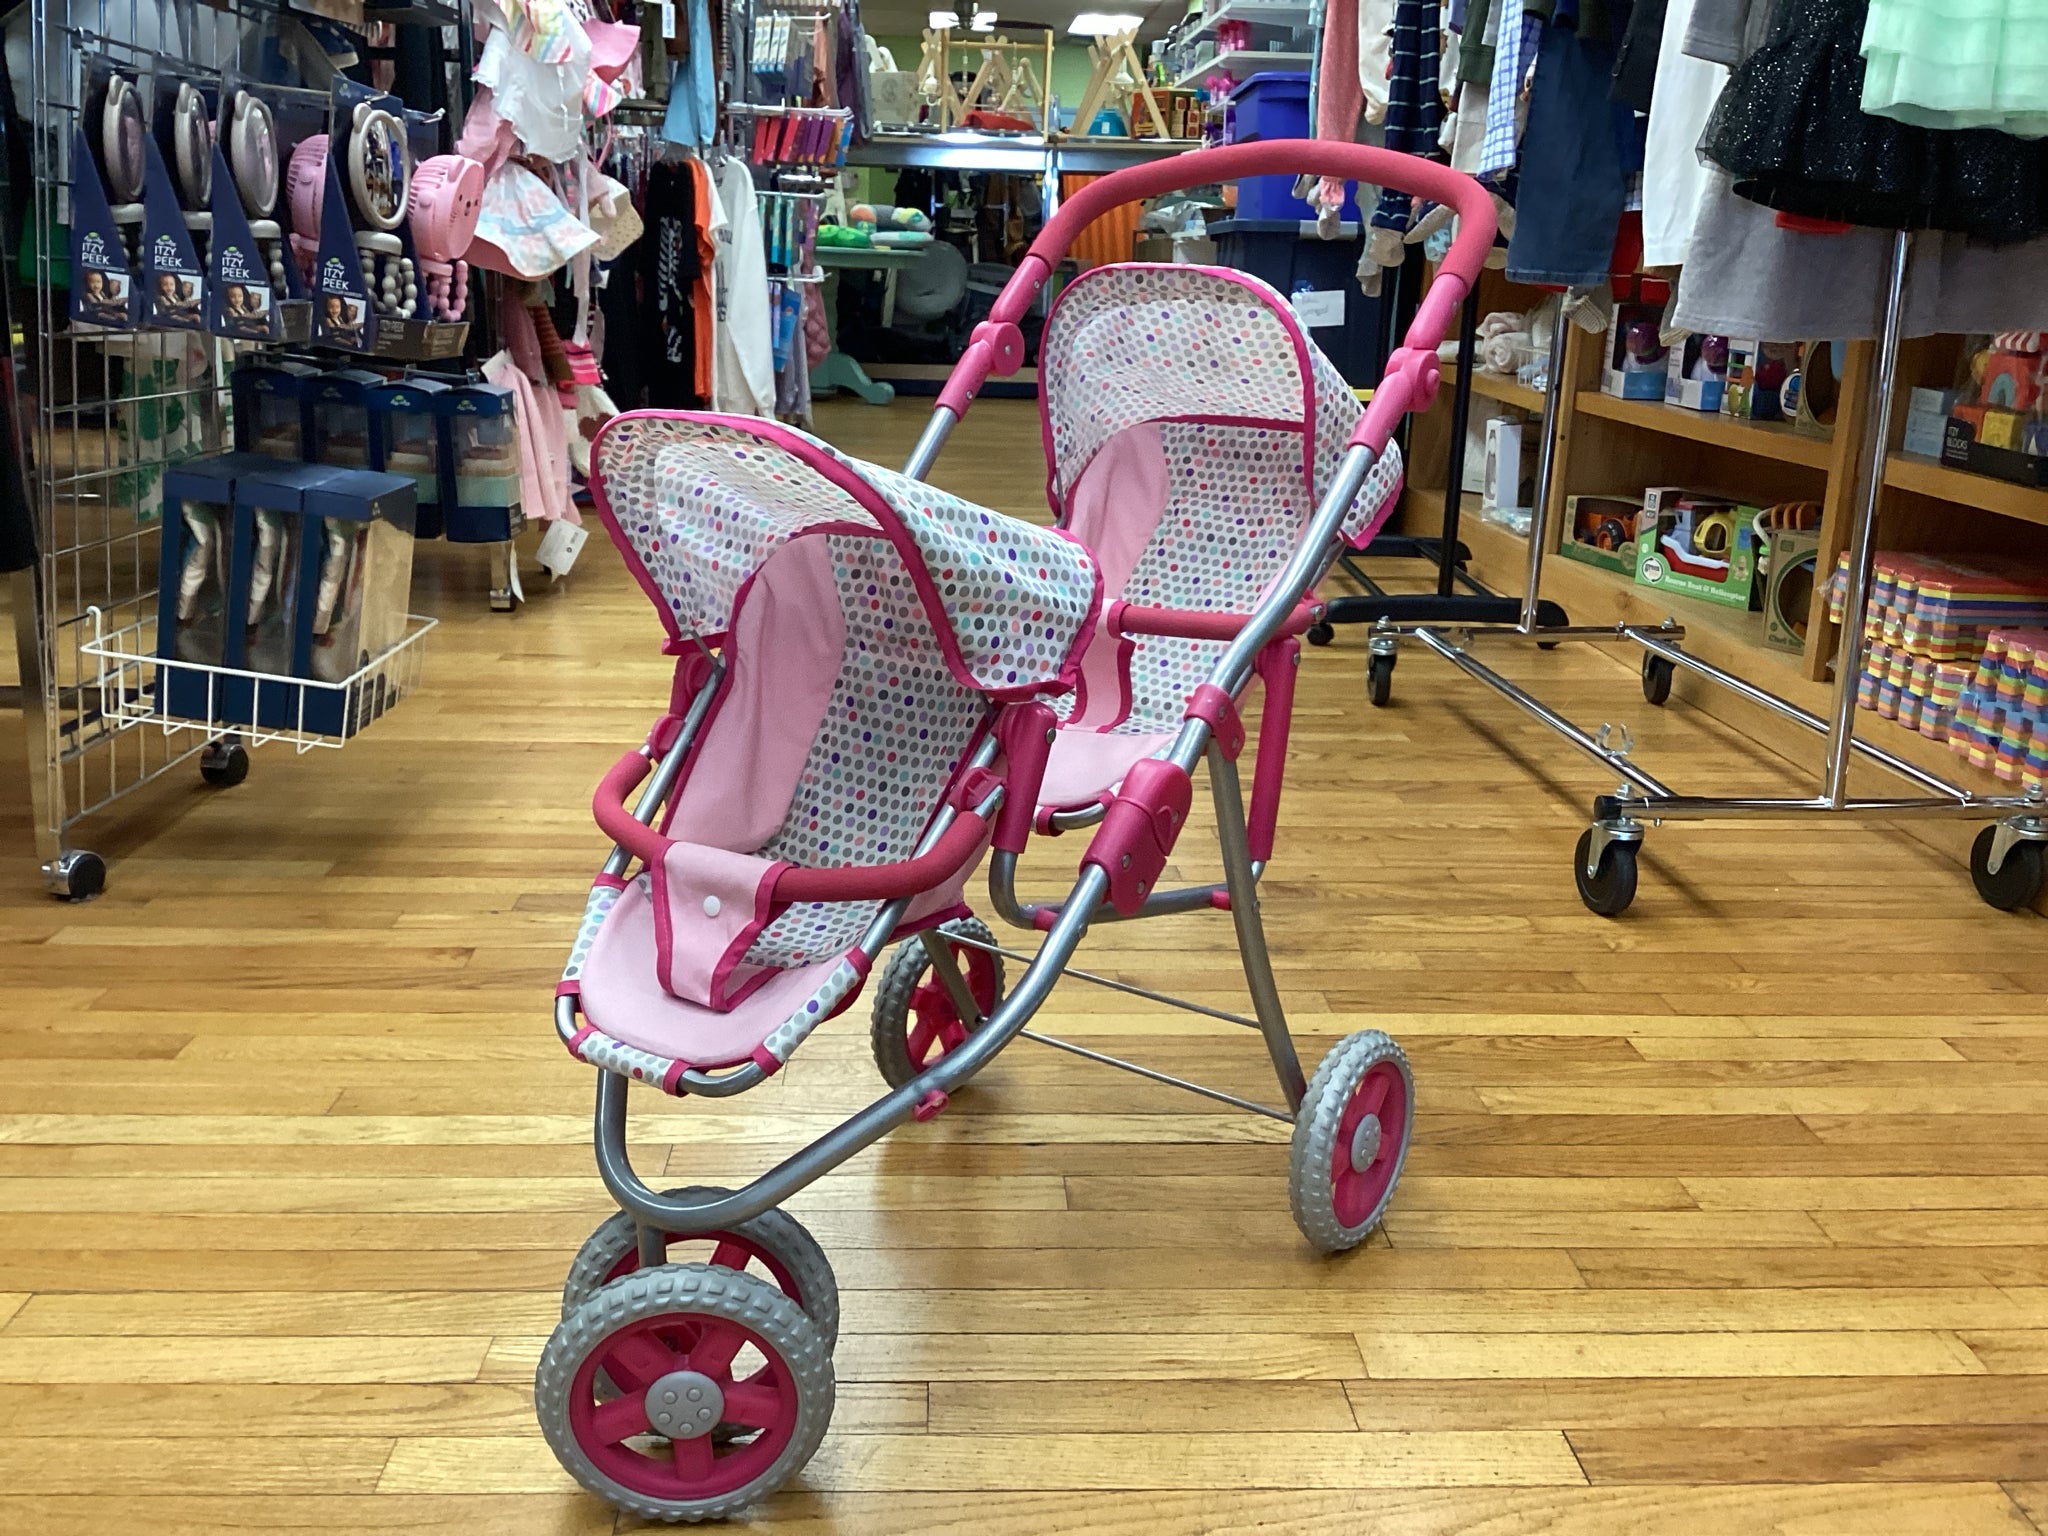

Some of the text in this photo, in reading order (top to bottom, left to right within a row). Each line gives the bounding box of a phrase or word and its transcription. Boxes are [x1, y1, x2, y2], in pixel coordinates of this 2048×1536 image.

[82, 242, 105, 254] ITZY
[154, 245, 177, 257] ITZY
[81, 252, 110, 265] PEEK
[154, 255, 182, 268] PEEK
[221, 257, 244, 268] ITZY
[221, 267, 250, 279] PEEK
[323, 267, 345, 279] ITZY
[322, 277, 350, 291] PEEK
